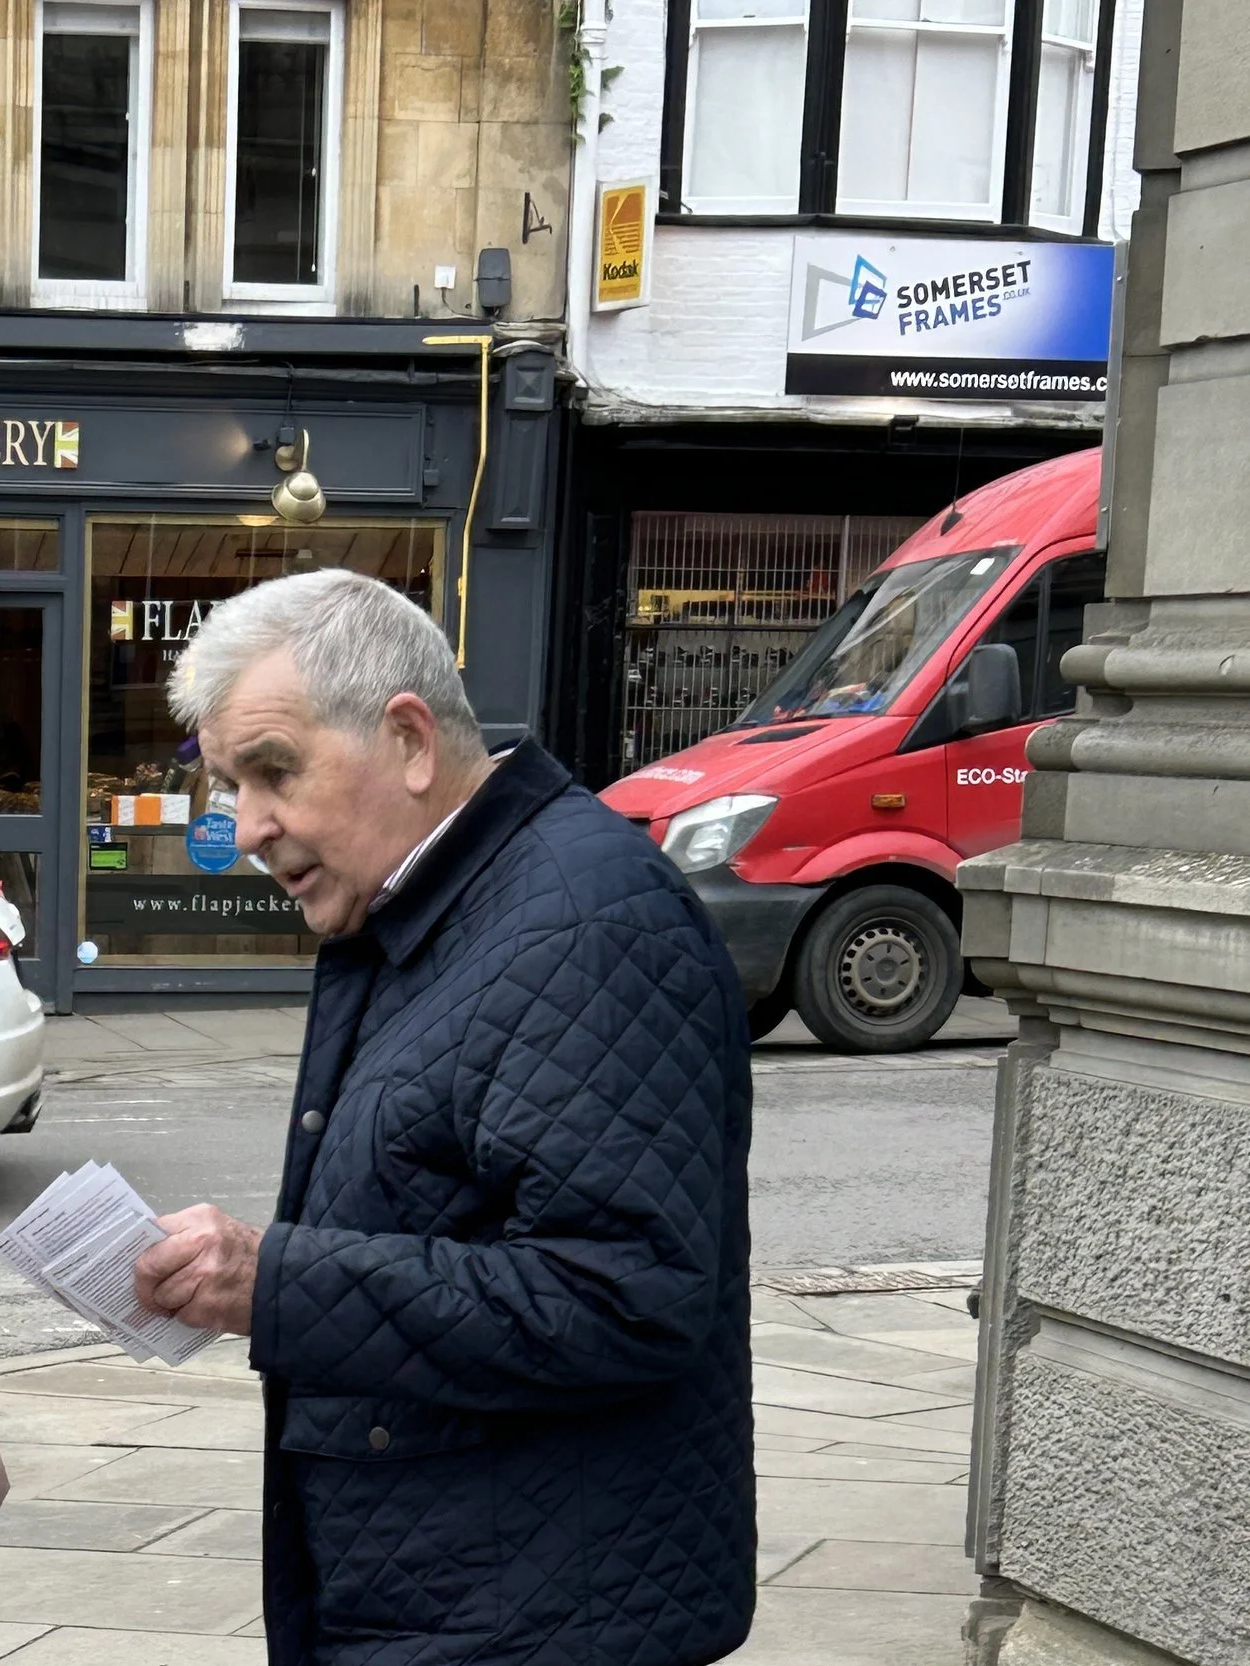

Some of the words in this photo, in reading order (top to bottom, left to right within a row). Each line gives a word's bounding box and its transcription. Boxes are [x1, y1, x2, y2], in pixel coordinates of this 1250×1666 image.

[603, 259, 638, 280] Kodak
[896, 260, 1032, 309] SOMERSET
[898, 294, 1002, 336] FRAMES
[141, 600, 222, 641] FLA
